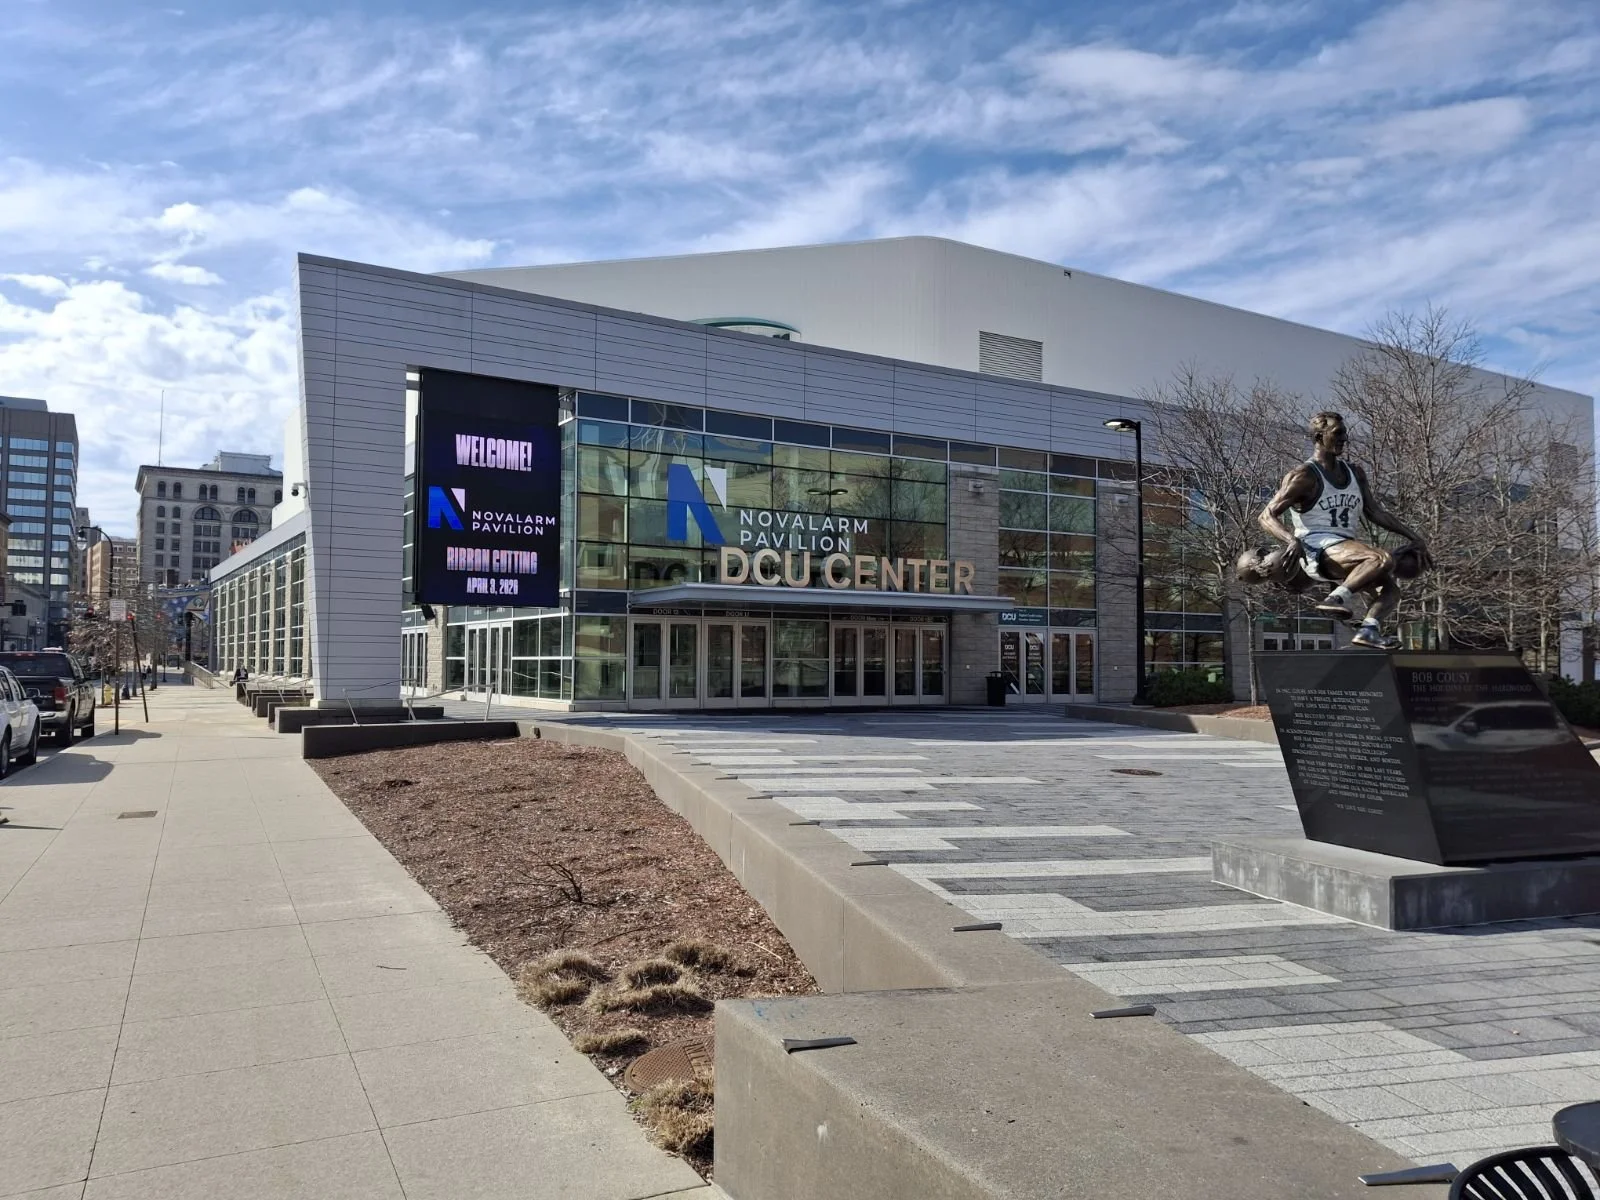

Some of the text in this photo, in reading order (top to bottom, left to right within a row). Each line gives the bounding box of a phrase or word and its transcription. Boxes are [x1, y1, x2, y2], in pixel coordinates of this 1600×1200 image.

[456, 433, 532, 472] WELCOME!
[1318, 494, 1360, 511] CELTICS
[472, 510, 556, 526] NOVALARM
[740, 509, 868, 534] NOVALARM
[1329, 507, 1350, 528] 14
[472, 521, 544, 536] PAVILION
[740, 530, 850, 552] PAVILION
[447, 546, 538, 575] RIBBON CUTTING
[720, 546, 975, 594] DCU CENTER
[466, 577, 489, 594] APRIL
[1002, 613, 1016, 621] DCU
[1412, 671, 1471, 683] BOB COUSY
